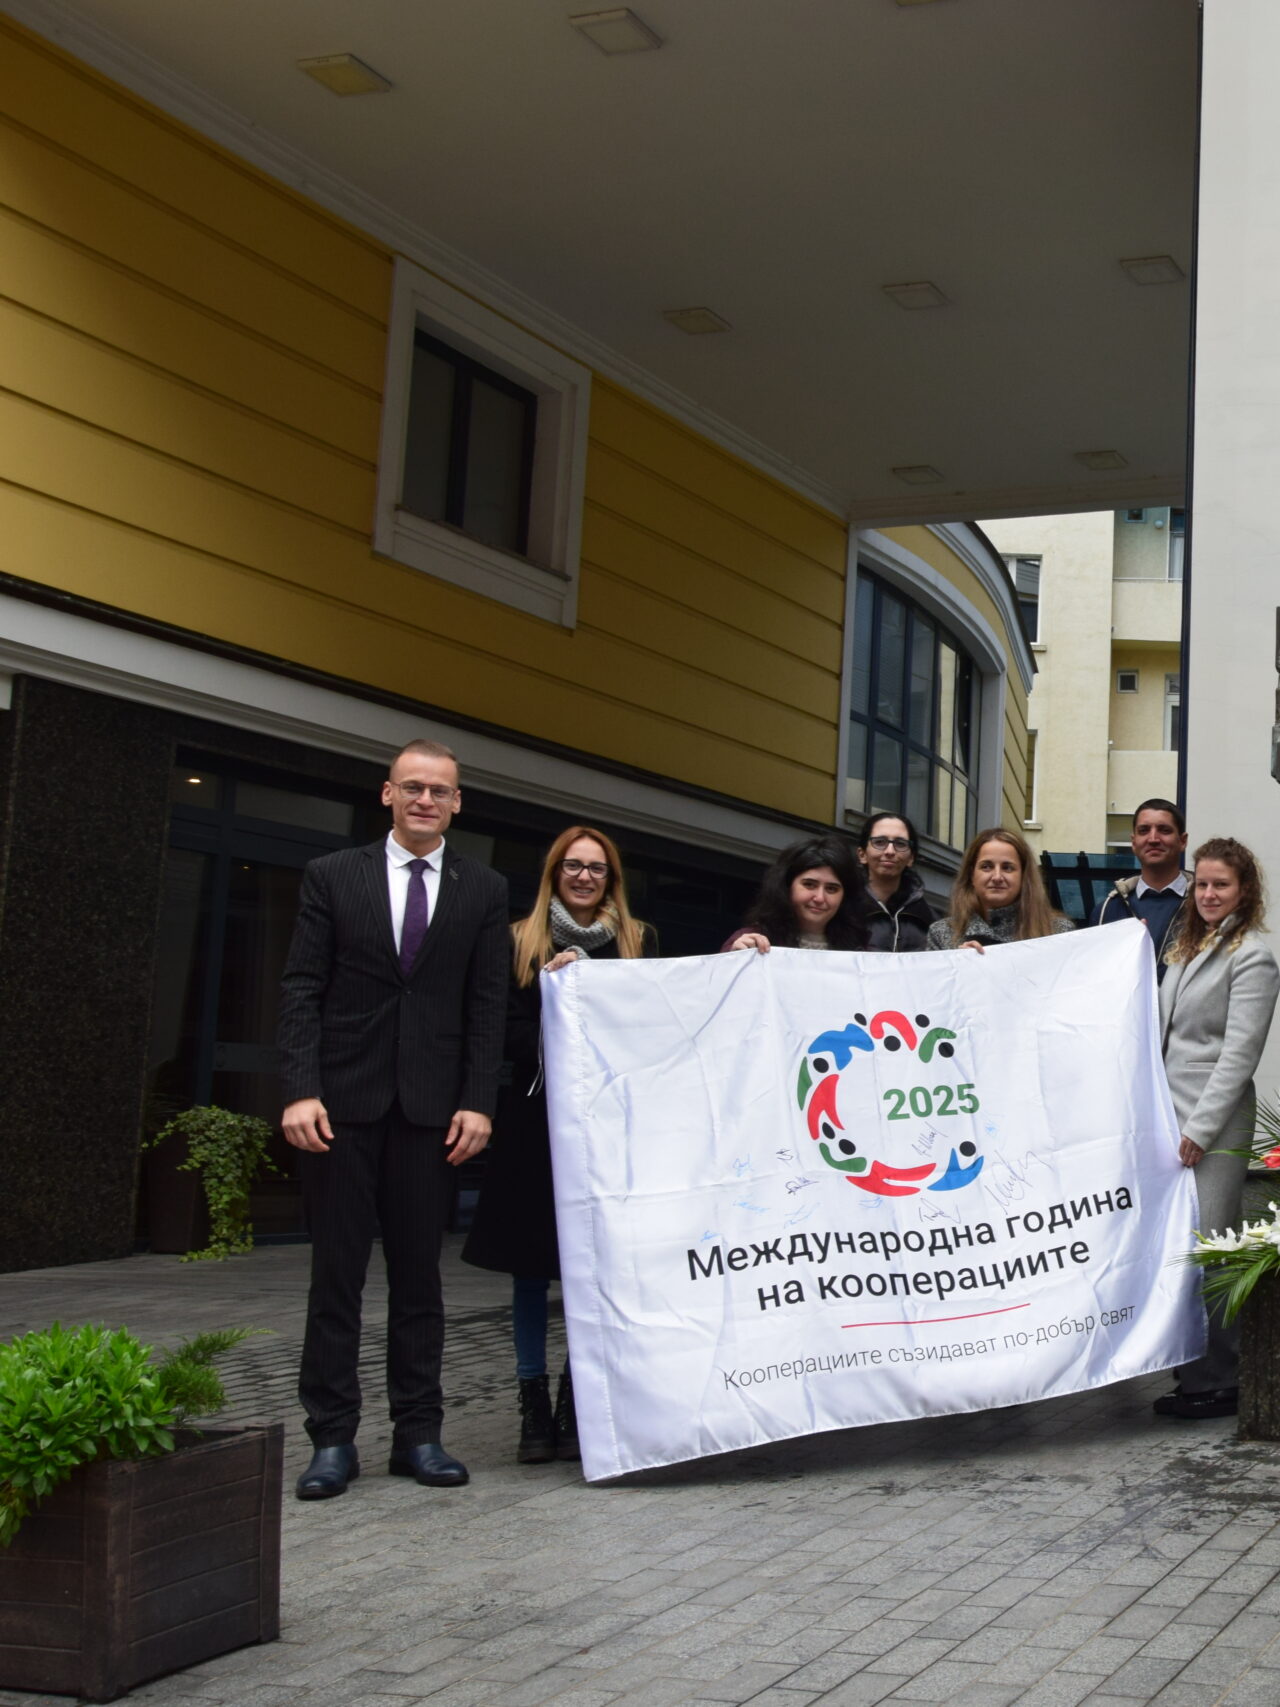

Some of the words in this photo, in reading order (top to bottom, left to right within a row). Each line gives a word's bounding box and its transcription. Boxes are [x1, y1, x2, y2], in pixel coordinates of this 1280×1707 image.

[883, 1083, 980, 1121] 2025
[687, 1221, 996, 1281] Международна
[1005, 1186, 1133, 1239] година
[757, 1278, 805, 1311] на
[817, 1239, 1091, 1301] кооперациите
[723, 1349, 883, 1390] Кооперациите
[887, 1335, 997, 1364] съзидават
[1003, 1310, 1096, 1348] по-добър
[1100, 1304, 1136, 1328] свят
